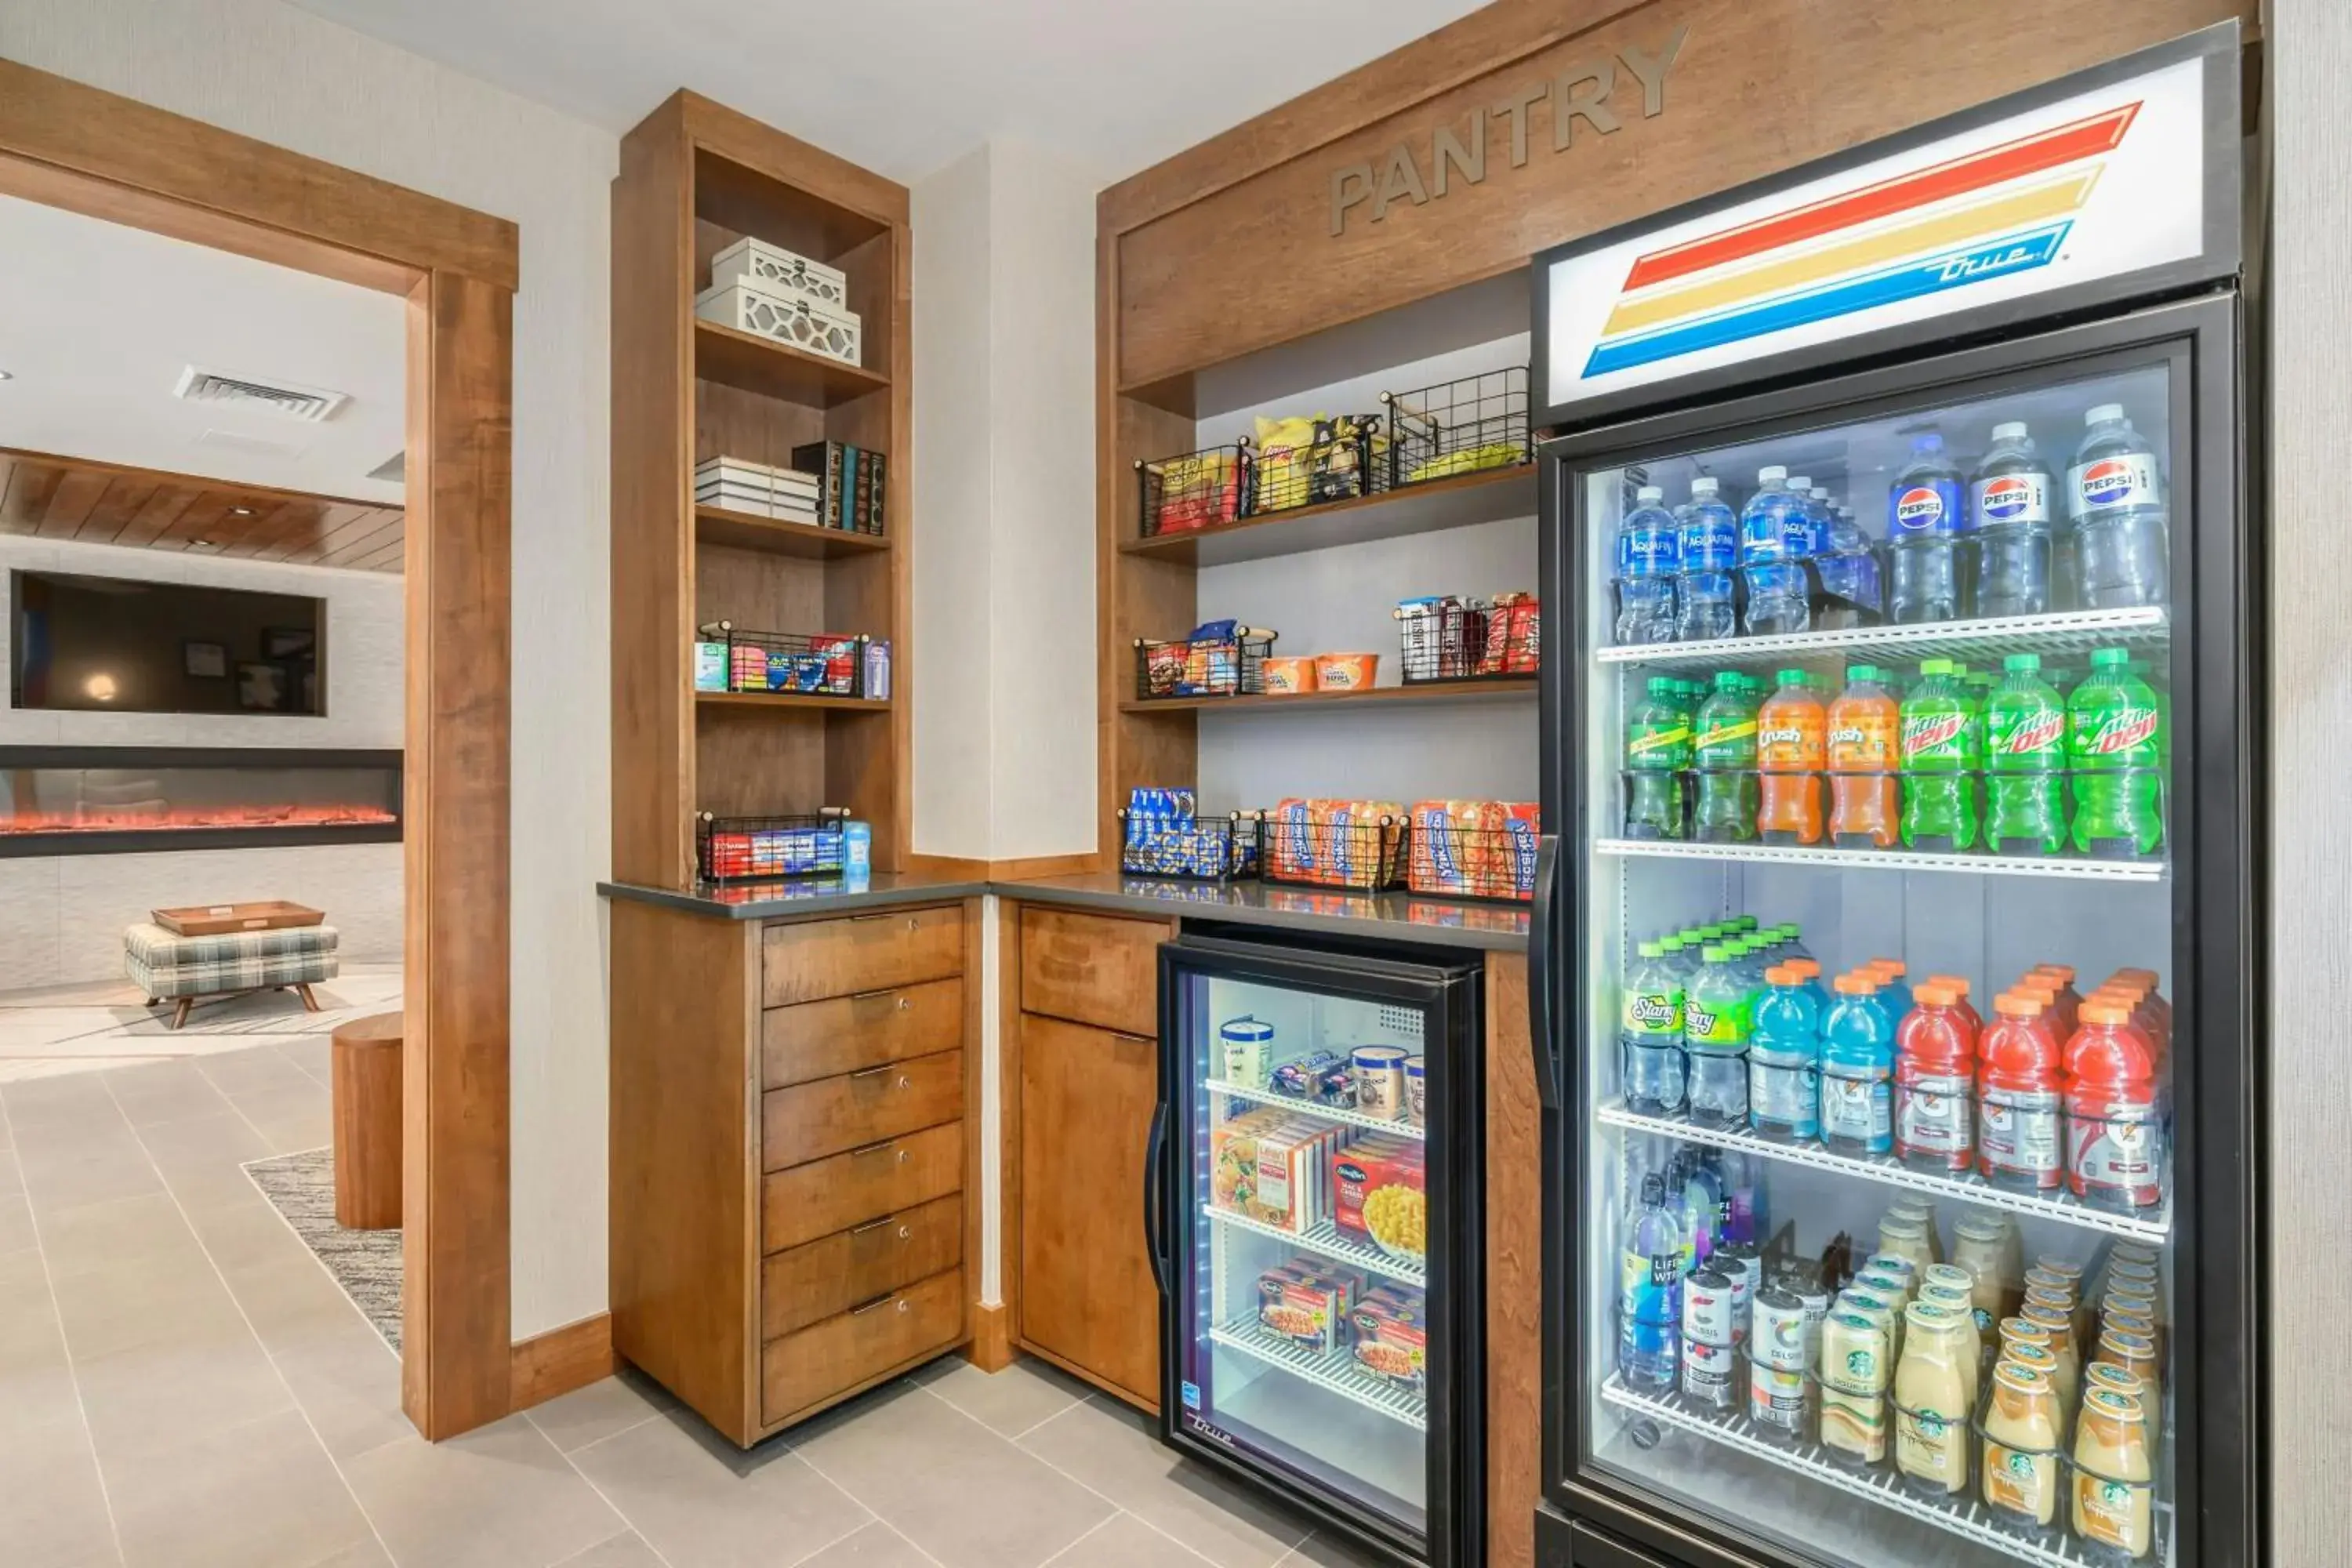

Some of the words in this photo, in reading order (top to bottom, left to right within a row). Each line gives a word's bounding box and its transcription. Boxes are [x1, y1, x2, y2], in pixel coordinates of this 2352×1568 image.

[1331, 24, 1691, 238] PANTRY
[2083, 475, 2132, 493] PEPSI
[1984, 491, 2029, 506] PEPSI
[1899, 502, 1940, 517] PEPSI
